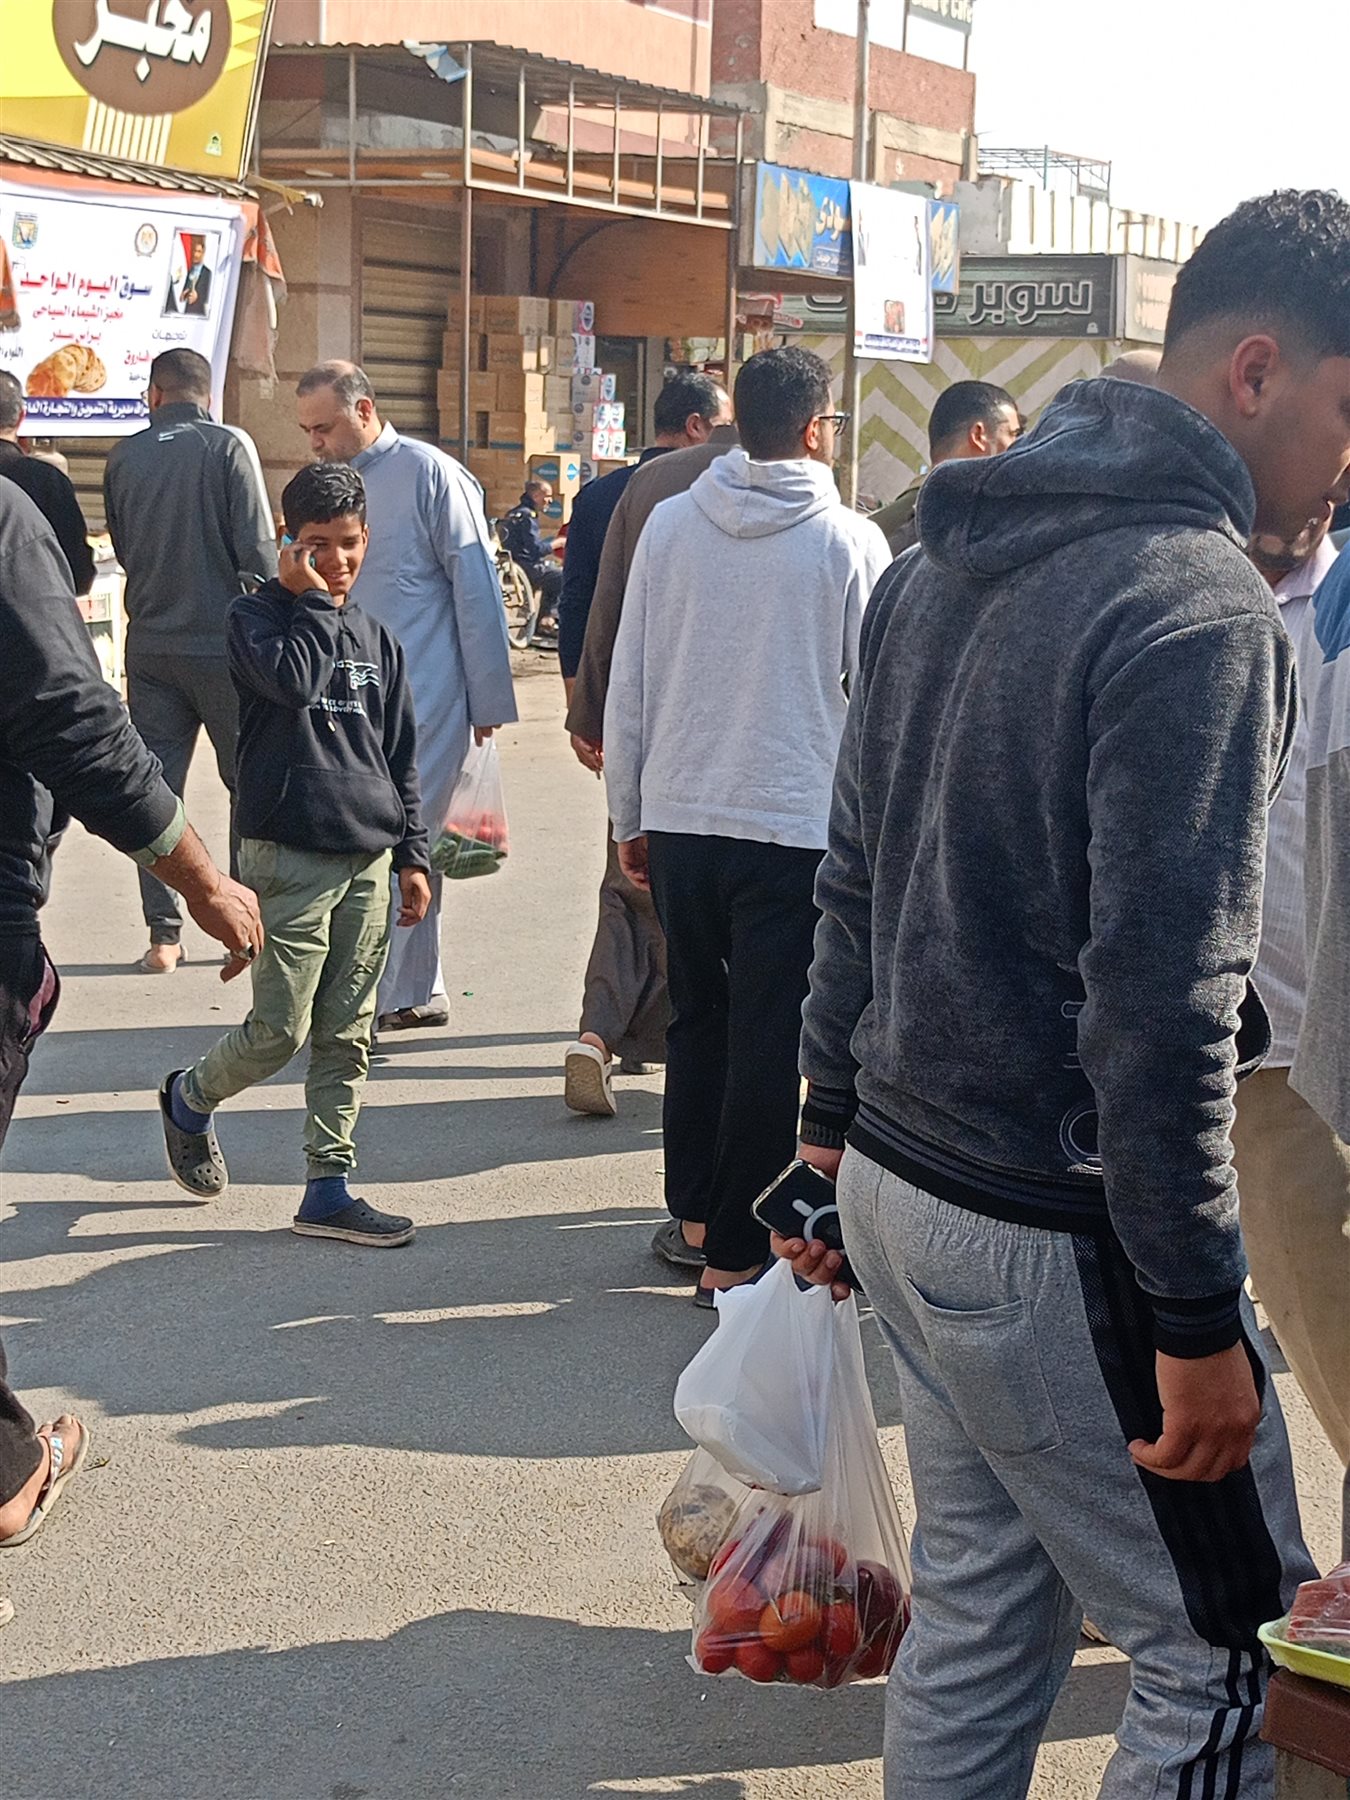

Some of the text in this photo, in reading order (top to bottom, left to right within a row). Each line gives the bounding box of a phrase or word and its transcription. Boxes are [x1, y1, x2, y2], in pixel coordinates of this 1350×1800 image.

[20, 271, 152, 300] سوق اليوم الواحد
[967, 281, 1093, 325] سوبر
